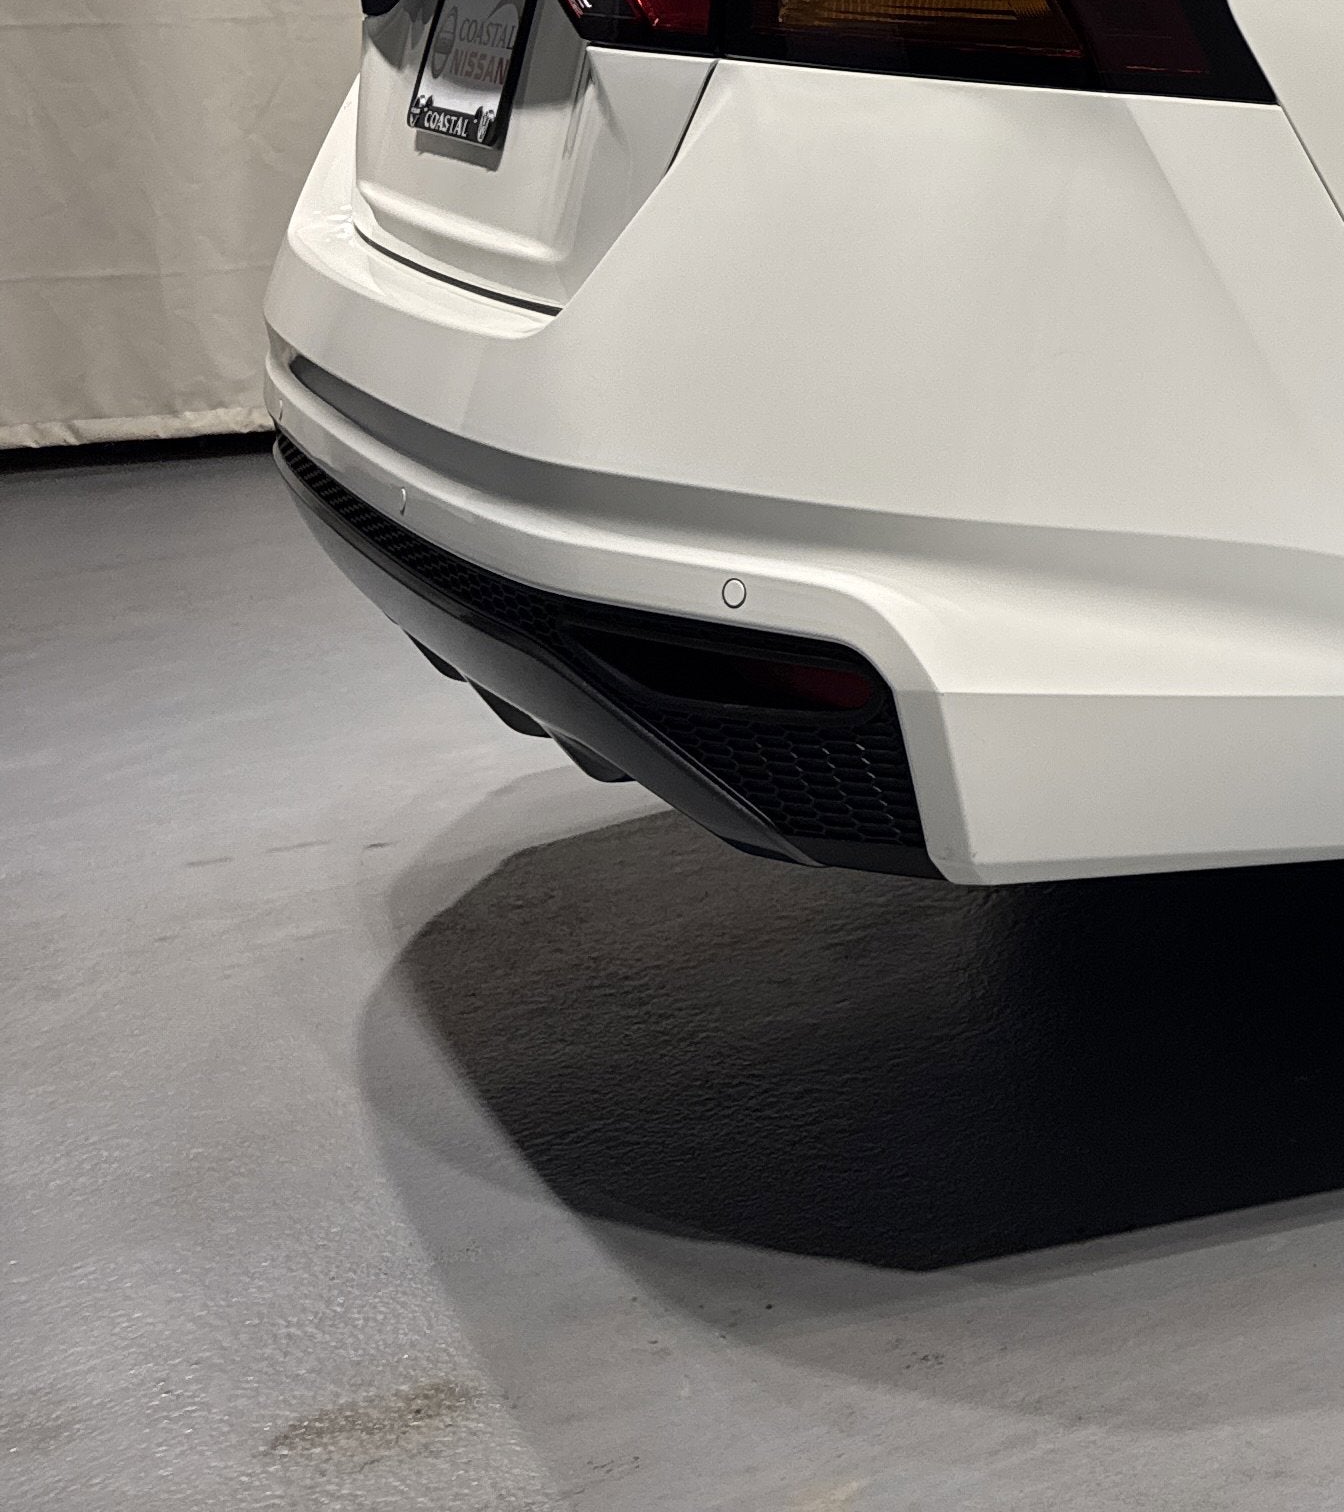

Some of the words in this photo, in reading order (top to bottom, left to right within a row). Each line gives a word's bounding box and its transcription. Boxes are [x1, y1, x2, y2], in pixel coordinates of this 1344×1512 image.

[459, 17, 517, 51] COASTAL
[449, 47, 511, 86] NISSAN
[424, 110, 470, 138] COASTAL
